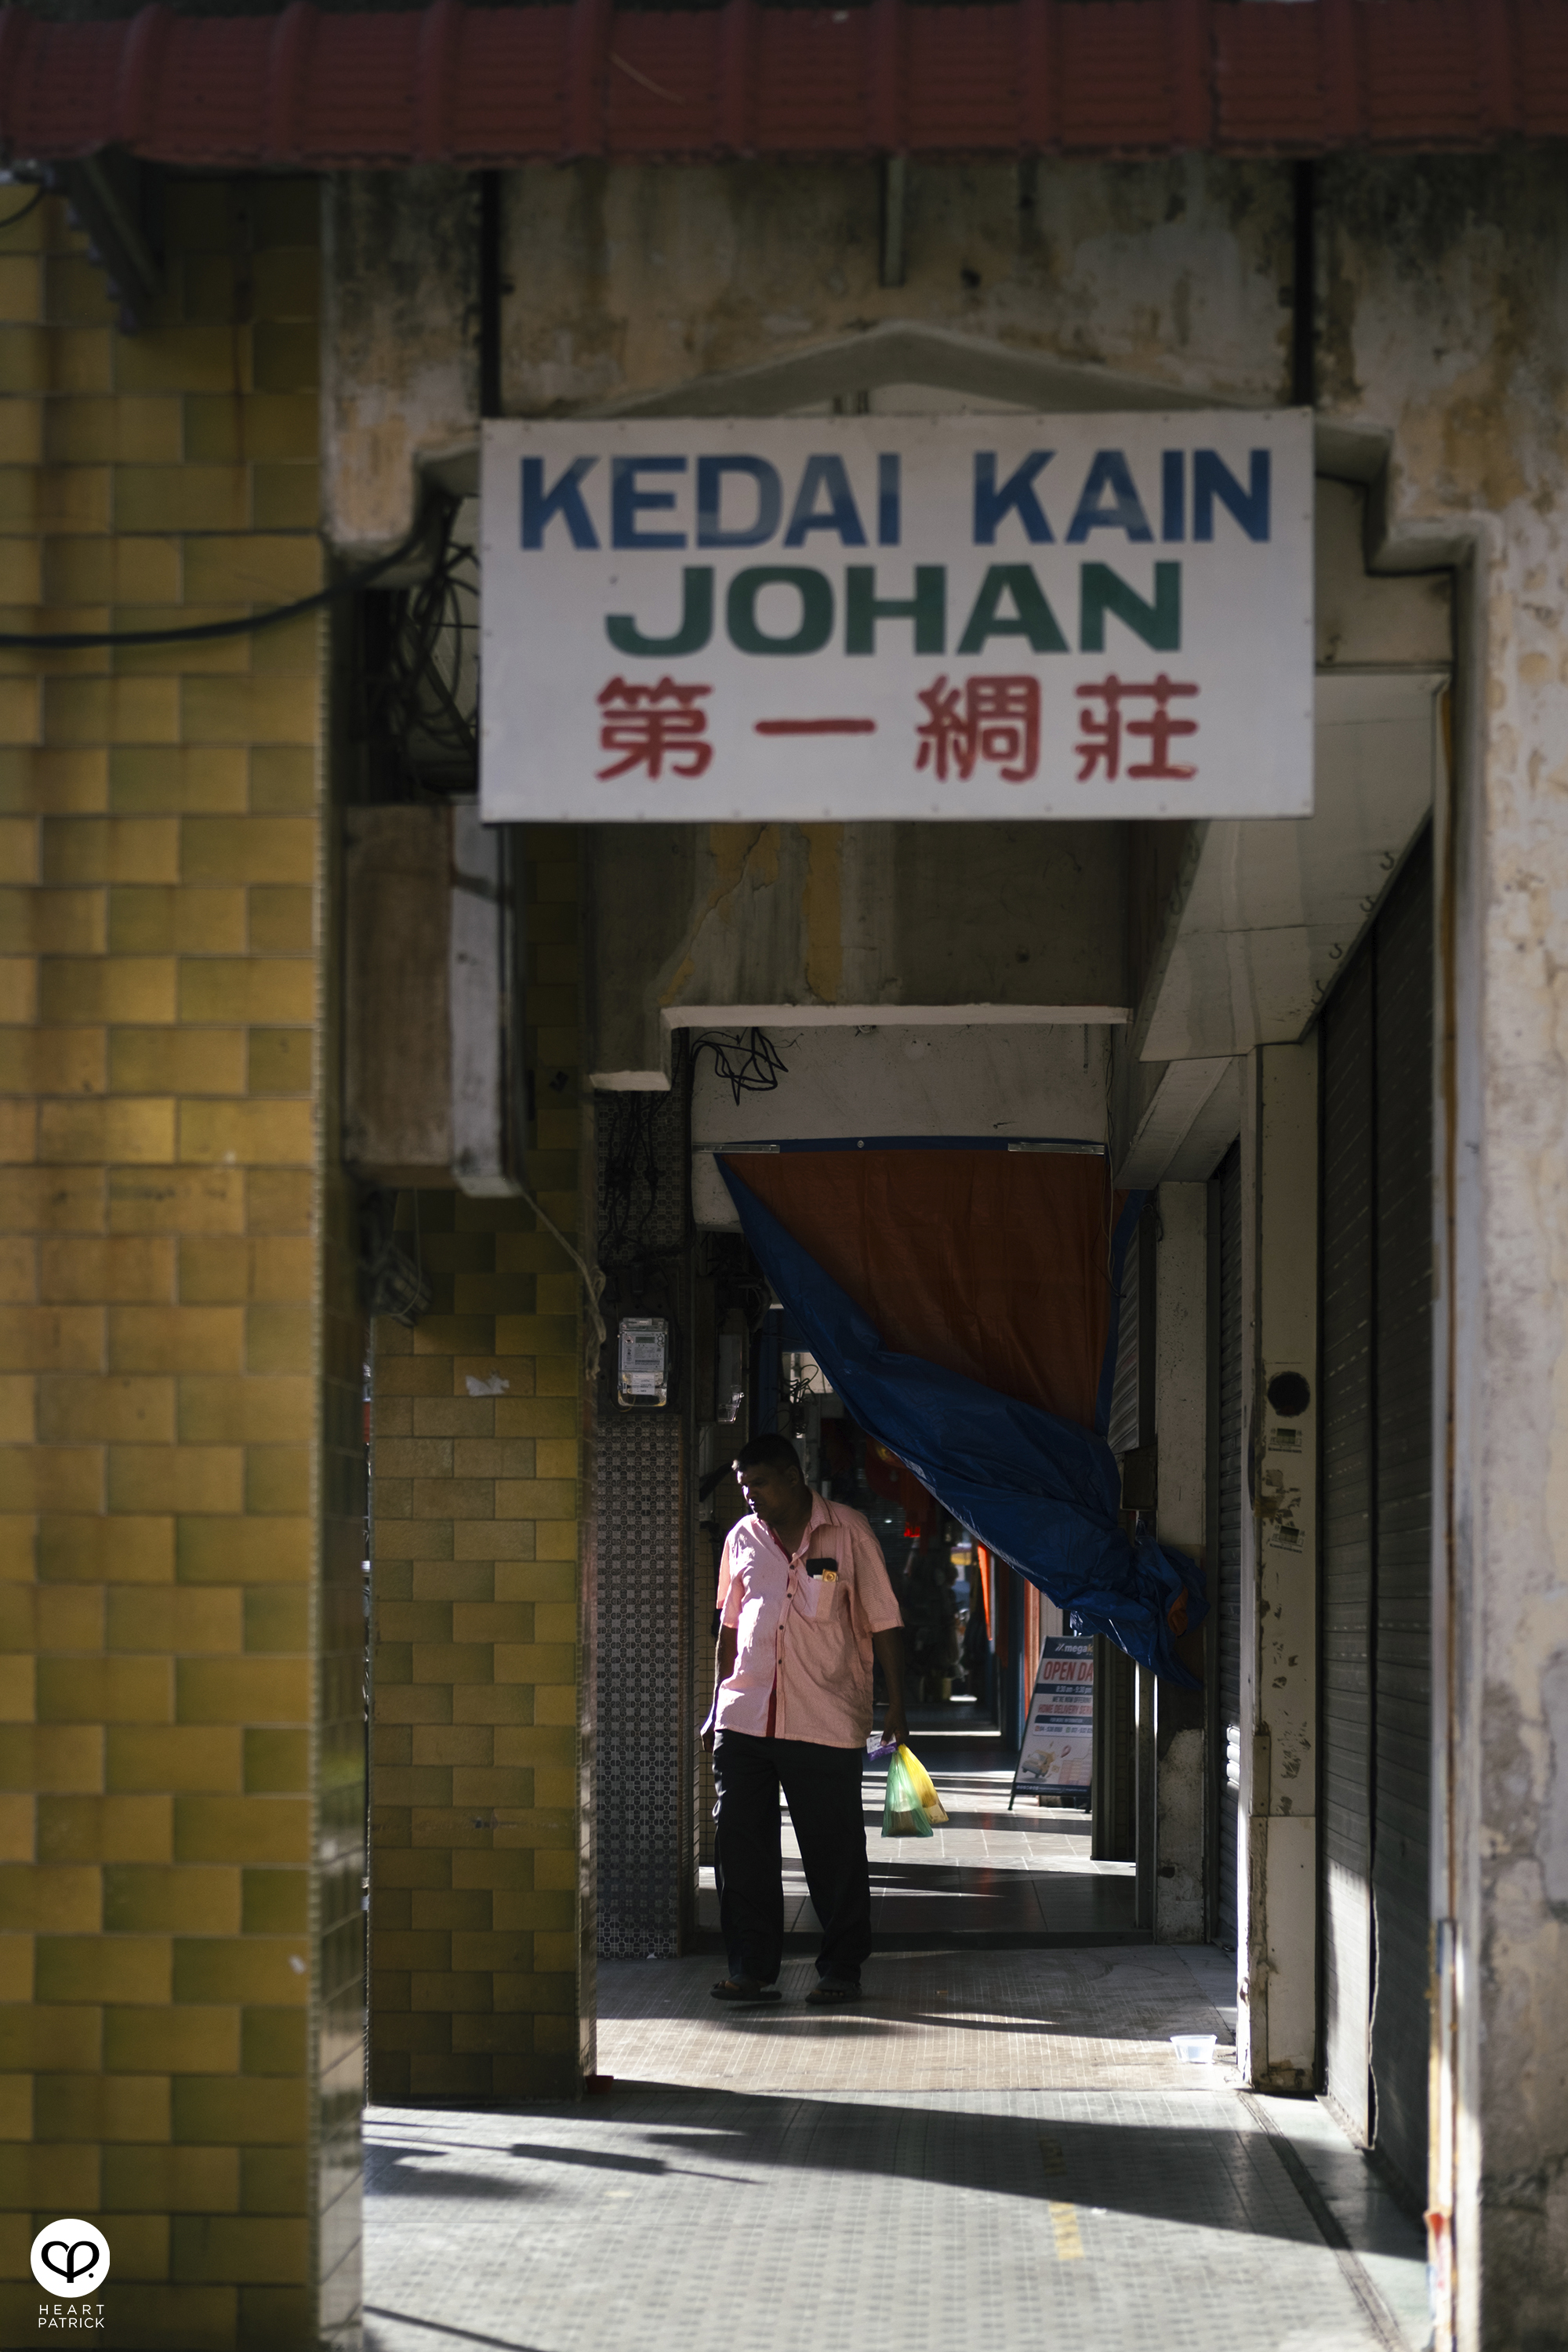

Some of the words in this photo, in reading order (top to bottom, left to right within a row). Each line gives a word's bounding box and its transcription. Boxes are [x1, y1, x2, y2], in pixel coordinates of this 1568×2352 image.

[520, 453, 900, 550] KEDAI
[972, 449, 1271, 546] KAIN
[604, 561, 1182, 658] JOHAN
[595, 674, 1200, 782] 第一綢莊
[1038, 1704, 1054, 1713] HOME
[1054, 1704, 1080, 1714] DELIVERY
[1044, 1661, 1076, 1681] OPEN
